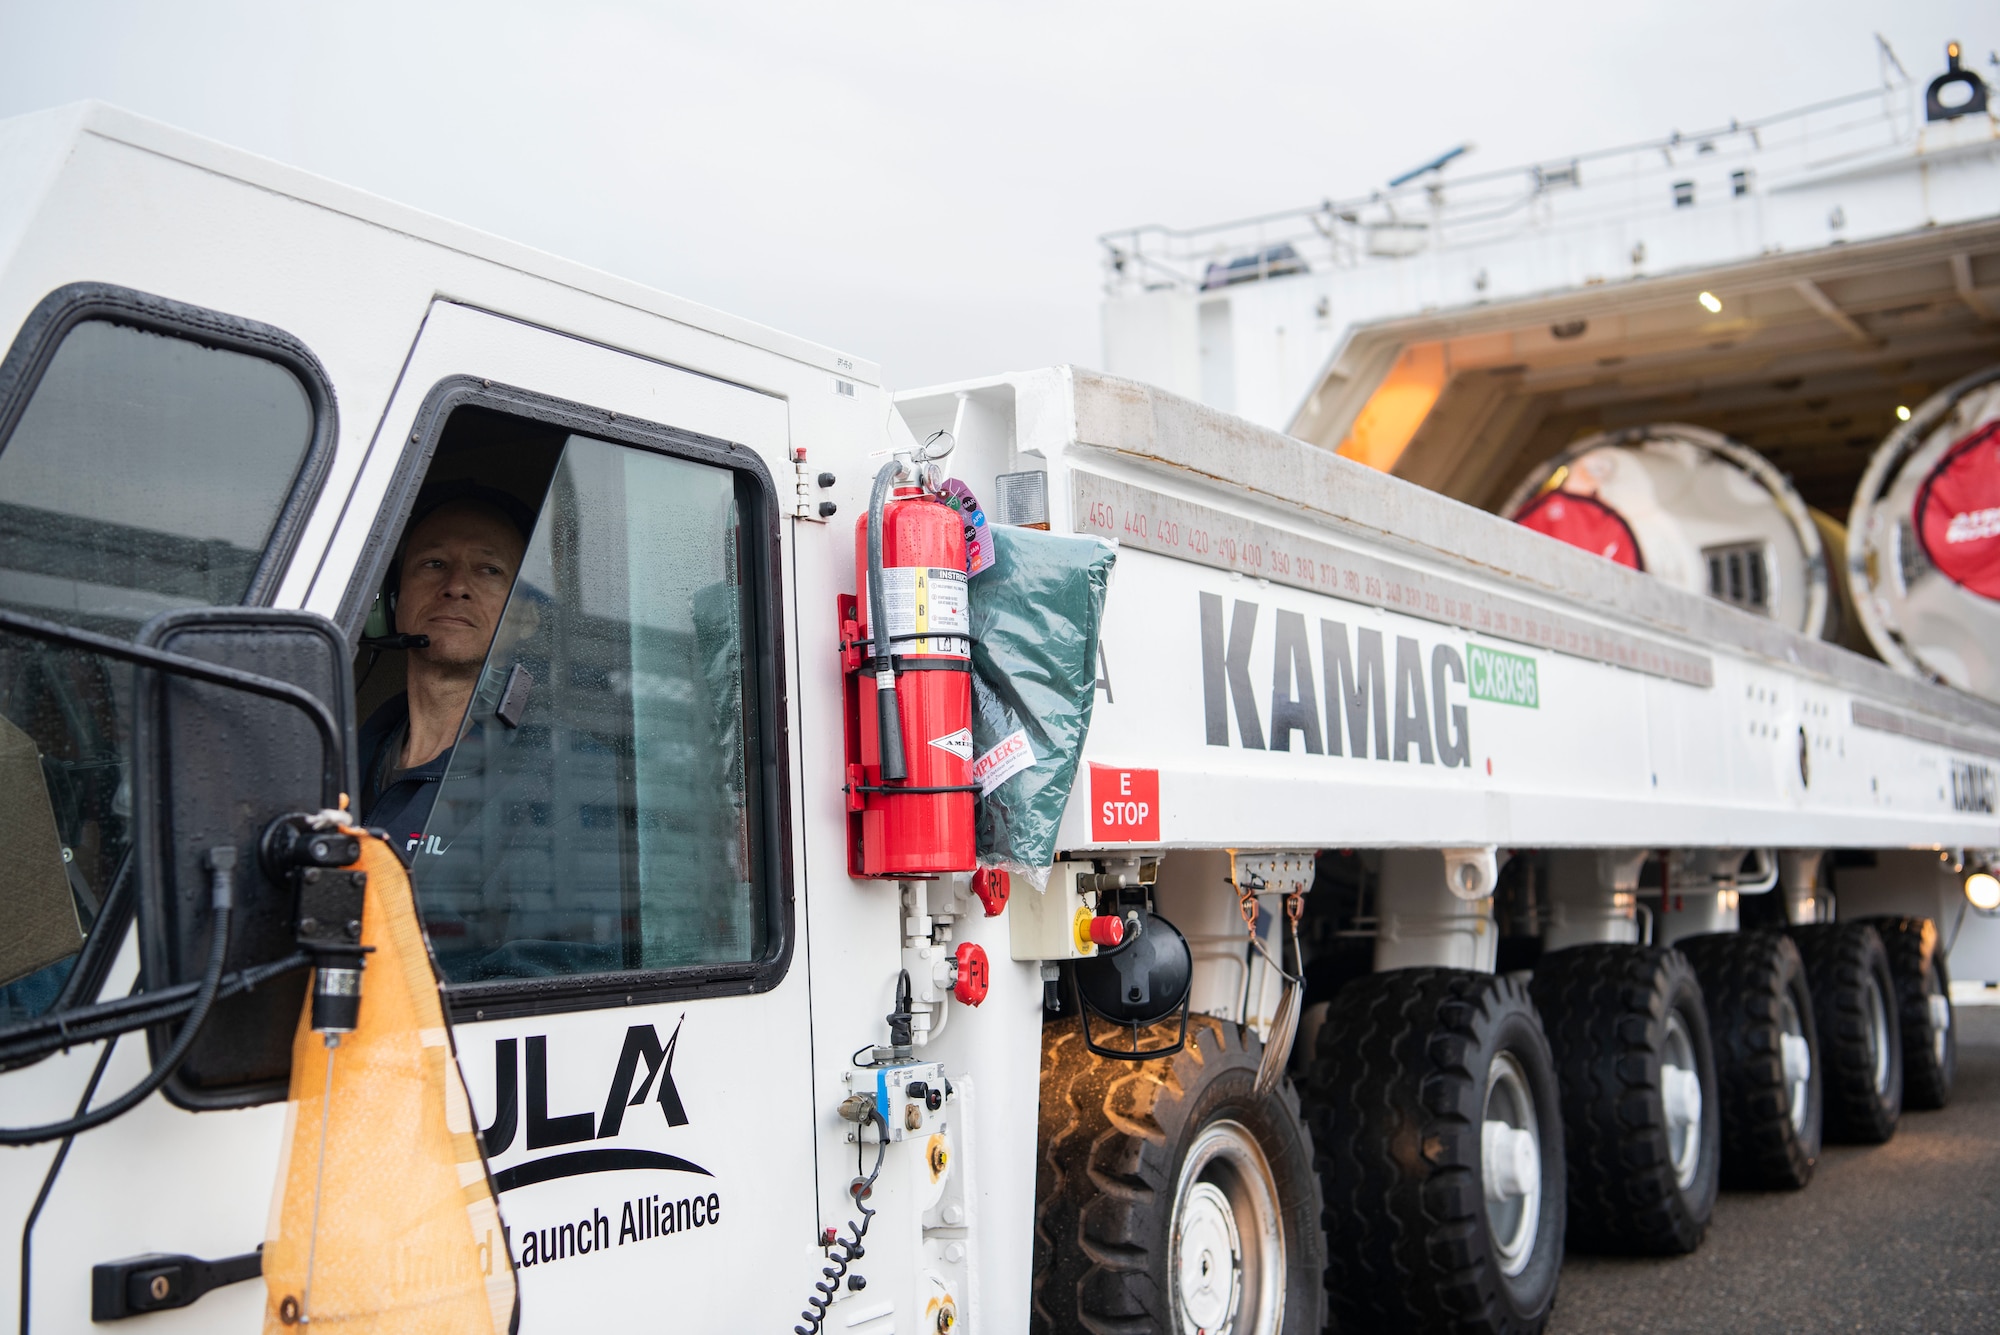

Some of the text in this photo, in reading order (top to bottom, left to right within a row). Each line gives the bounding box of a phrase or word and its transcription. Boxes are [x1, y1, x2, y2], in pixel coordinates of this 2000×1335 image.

[1090, 502, 1114, 529] 450
[1124, 511, 1147, 538] 440
[1157, 520, 1179, 546] 430
[1188, 528, 1209, 554] 420
[1218, 537, 1236, 560] 410
[1242, 544, 1262, 567] 400
[1271, 550, 1290, 574] 390
[918, 576, 925, 588] A
[918, 604, 925, 616] B
[1199, 591, 1472, 768] KAMAG
[1469, 648, 1537, 706] CX8X96
[1120, 772, 1132, 796] E
[1102, 801, 1150, 826] STOP
[618, 1192, 720, 1246] Alliance
